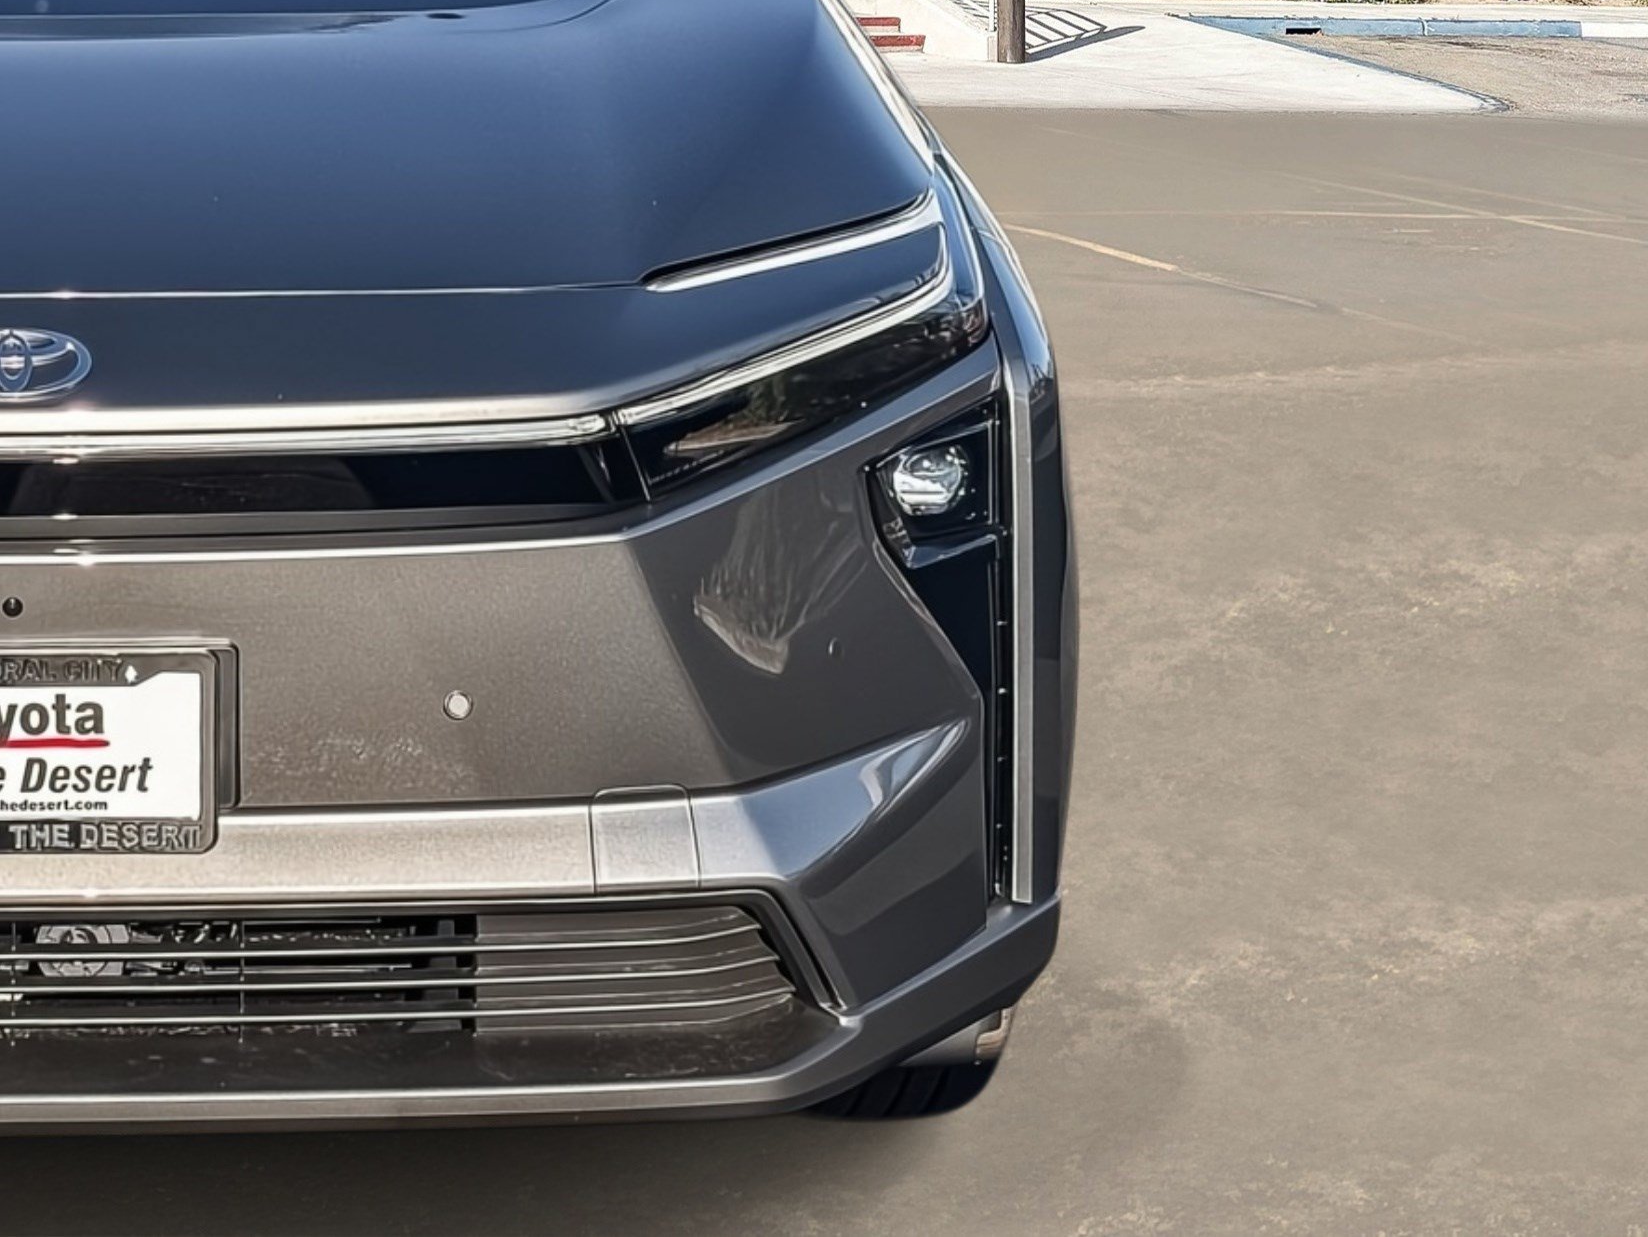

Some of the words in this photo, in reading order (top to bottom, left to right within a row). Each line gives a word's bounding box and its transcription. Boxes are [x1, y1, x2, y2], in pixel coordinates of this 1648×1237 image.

[19, 758, 153, 795] Desert
[9, 824, 70, 850] THE
[80, 824, 201, 850] DESERT
